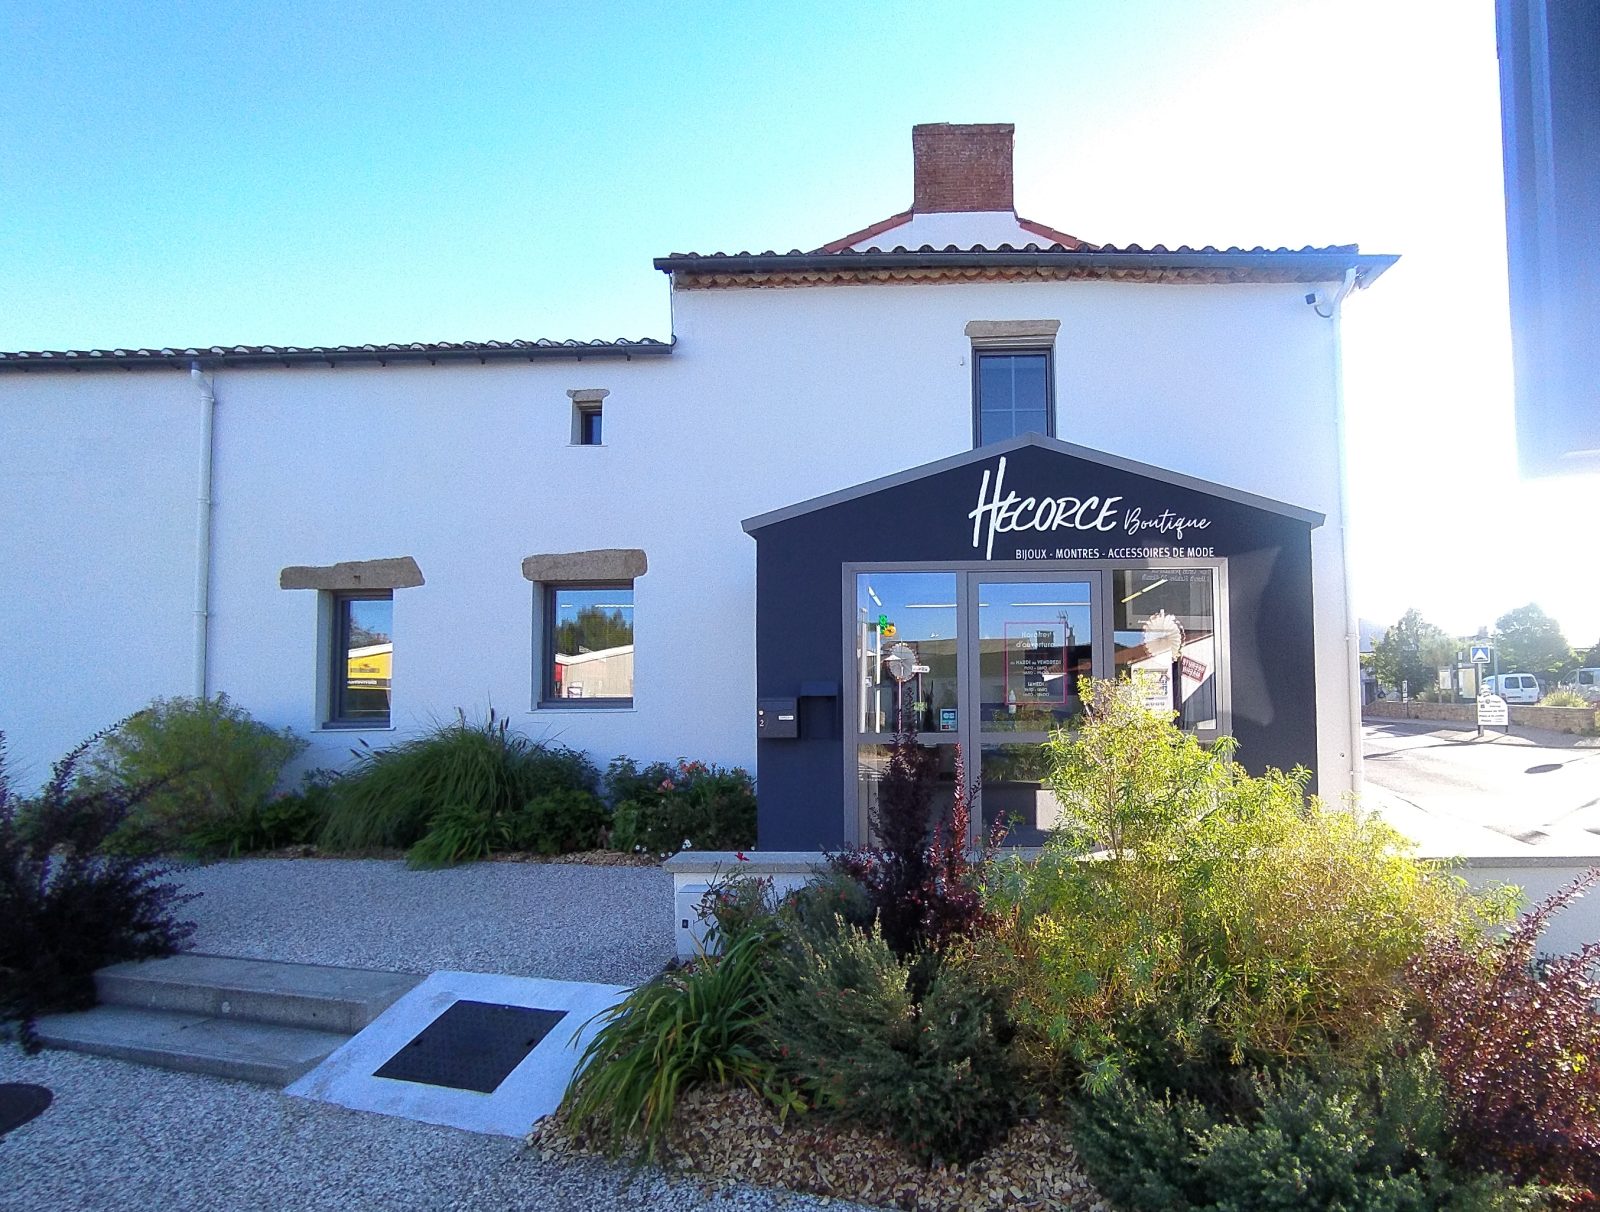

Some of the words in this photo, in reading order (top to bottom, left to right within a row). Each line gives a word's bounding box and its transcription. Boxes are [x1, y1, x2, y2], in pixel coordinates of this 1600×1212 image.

[1124, 507, 1212, 540] Boutique
[1015, 549, 1047, 561] BIJOUX
[1055, 548, 1100, 559] MONTRES
[1107, 547, 1171, 558] ACCESSOIRES
[1172, 547, 1185, 558] DE
[1187, 547, 1214, 557] MODE
[759, 719, 765, 727] 2
